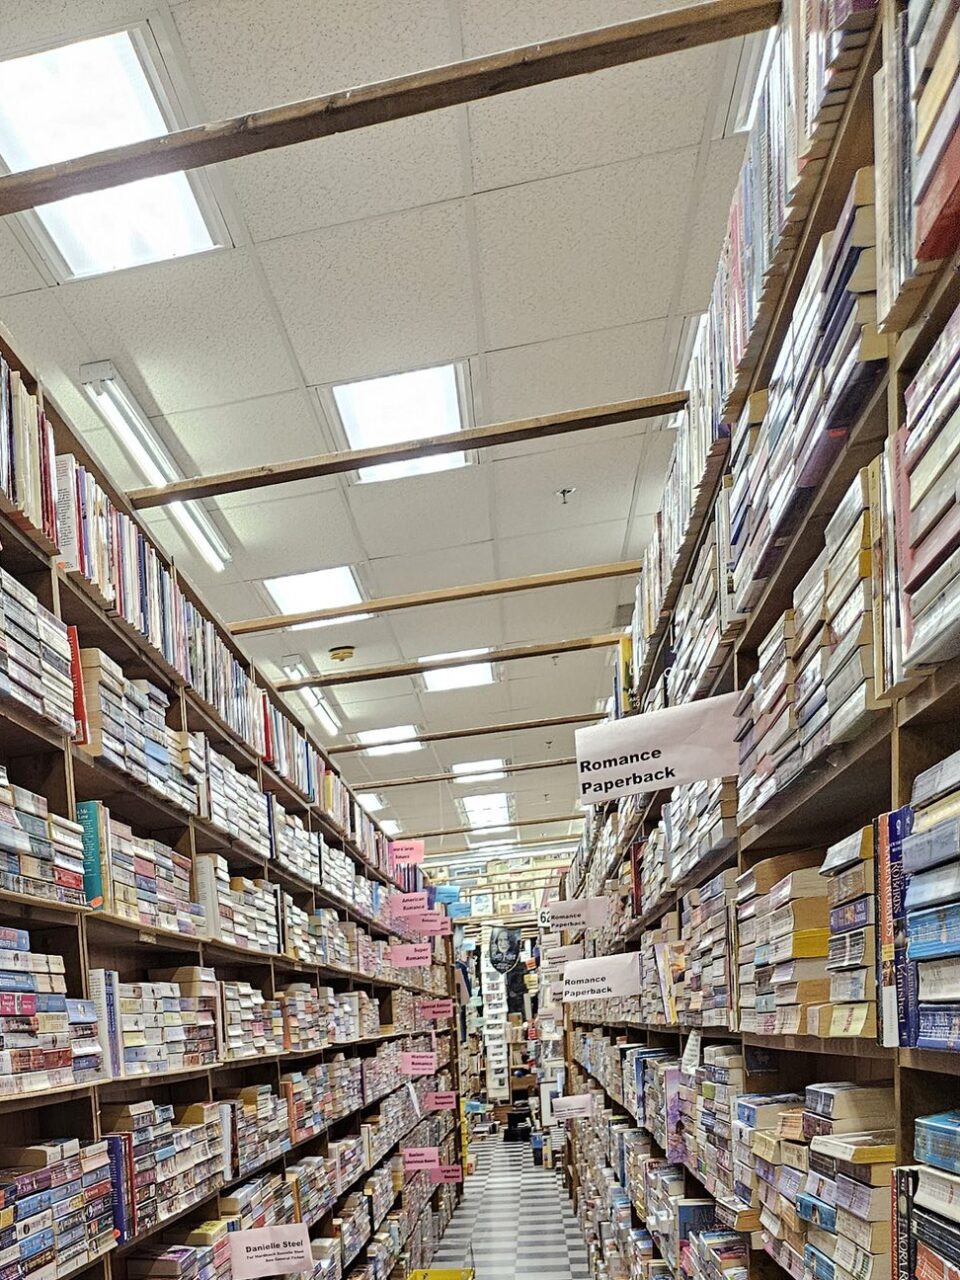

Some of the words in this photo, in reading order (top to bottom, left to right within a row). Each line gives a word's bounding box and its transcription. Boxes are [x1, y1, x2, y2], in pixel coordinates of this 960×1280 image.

[580, 748, 662, 773] Romance
[581, 766, 676, 794] Paperback
[550, 912, 582, 921] Romance
[551, 920, 586, 929] Paperback
[564, 975, 607, 987] Romance
[564, 986, 613, 998] Paperback
[246, 1242, 281, 1253] Danielle
[283, 1239, 304, 1249] Steel
[897, 1233, 908, 1267] NORA
